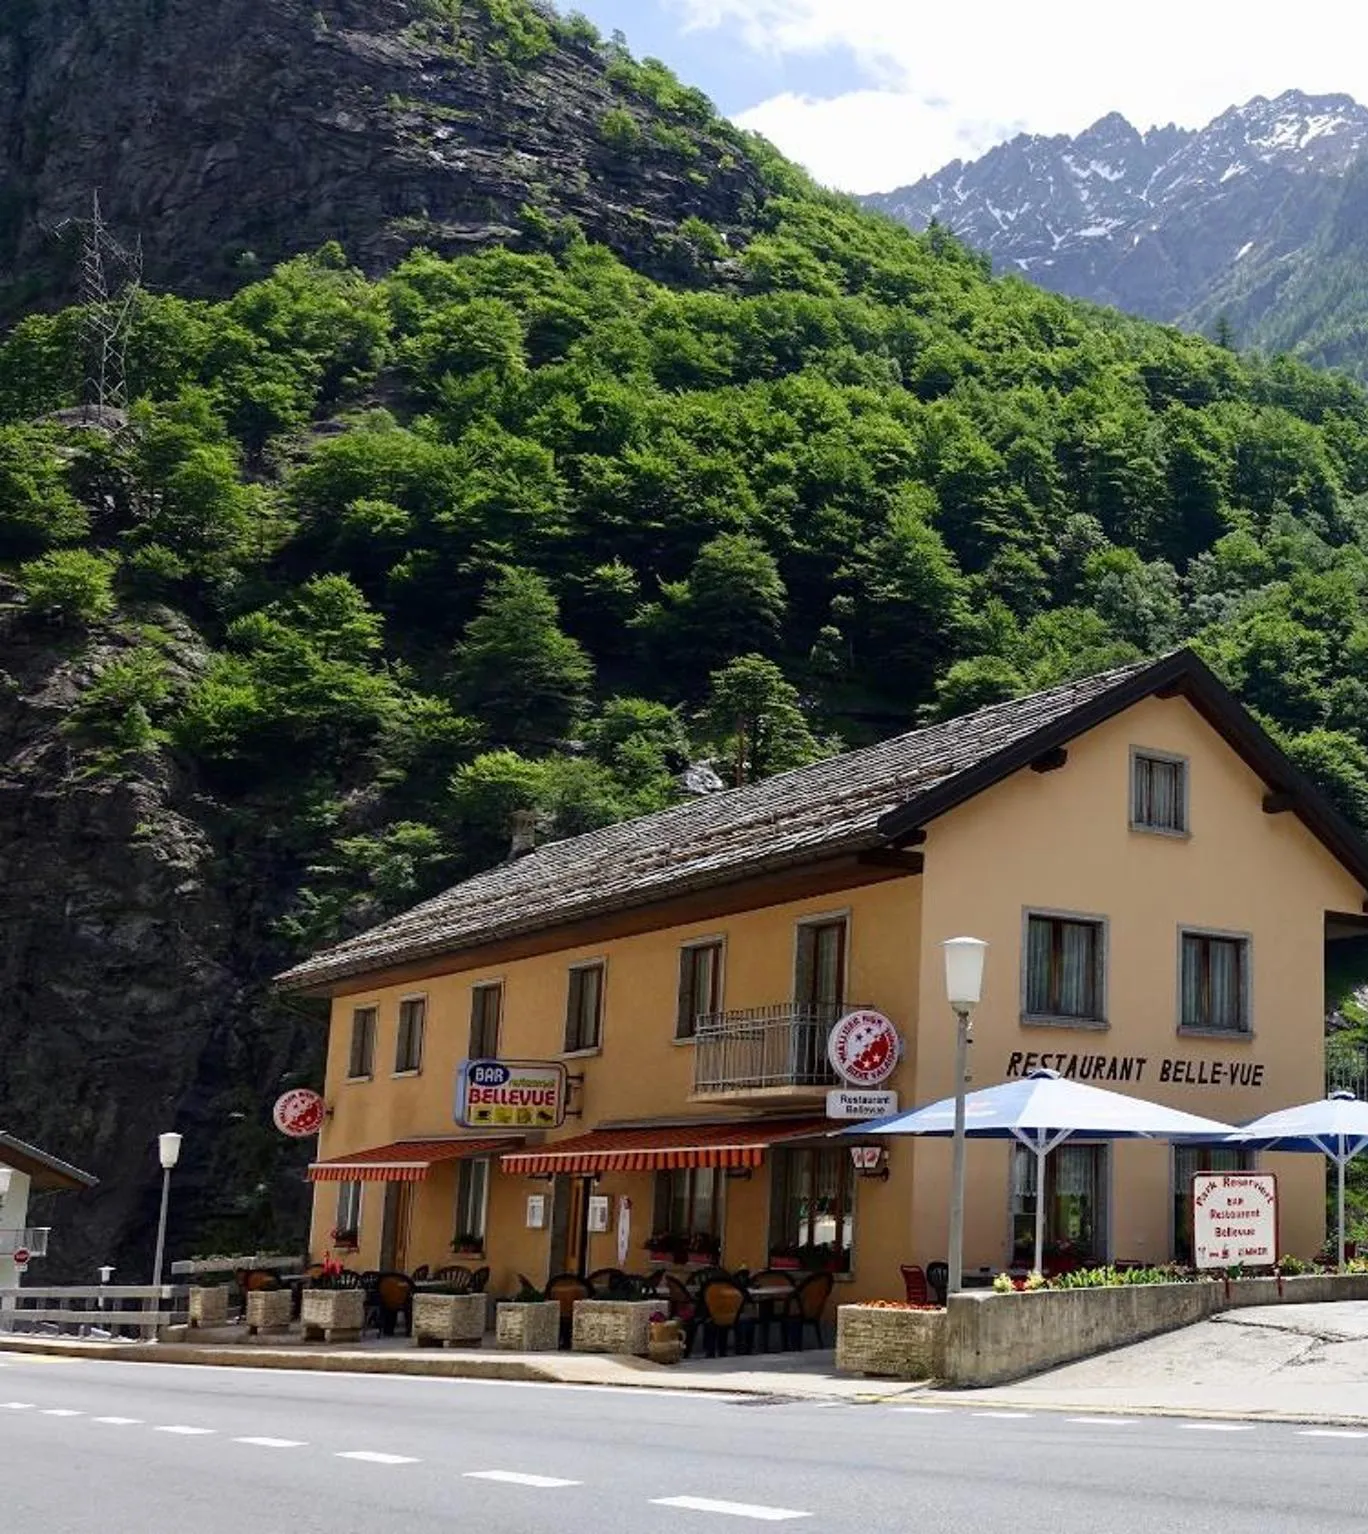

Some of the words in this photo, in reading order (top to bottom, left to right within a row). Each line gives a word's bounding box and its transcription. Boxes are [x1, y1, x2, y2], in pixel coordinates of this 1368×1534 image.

[1006, 1051, 1147, 1081] RESTAURANT
[1159, 1059, 1265, 1086] BELLE-VUE
[475, 1067, 505, 1083] BAR
[468, 1087, 556, 1106] BELLEVUE
[840, 1094, 891, 1104] Restaurant
[845, 1104, 886, 1115] Bellevue
[1210, 1208, 1261, 1219] Restaurant
[1215, 1226, 1256, 1238] Bellevue
